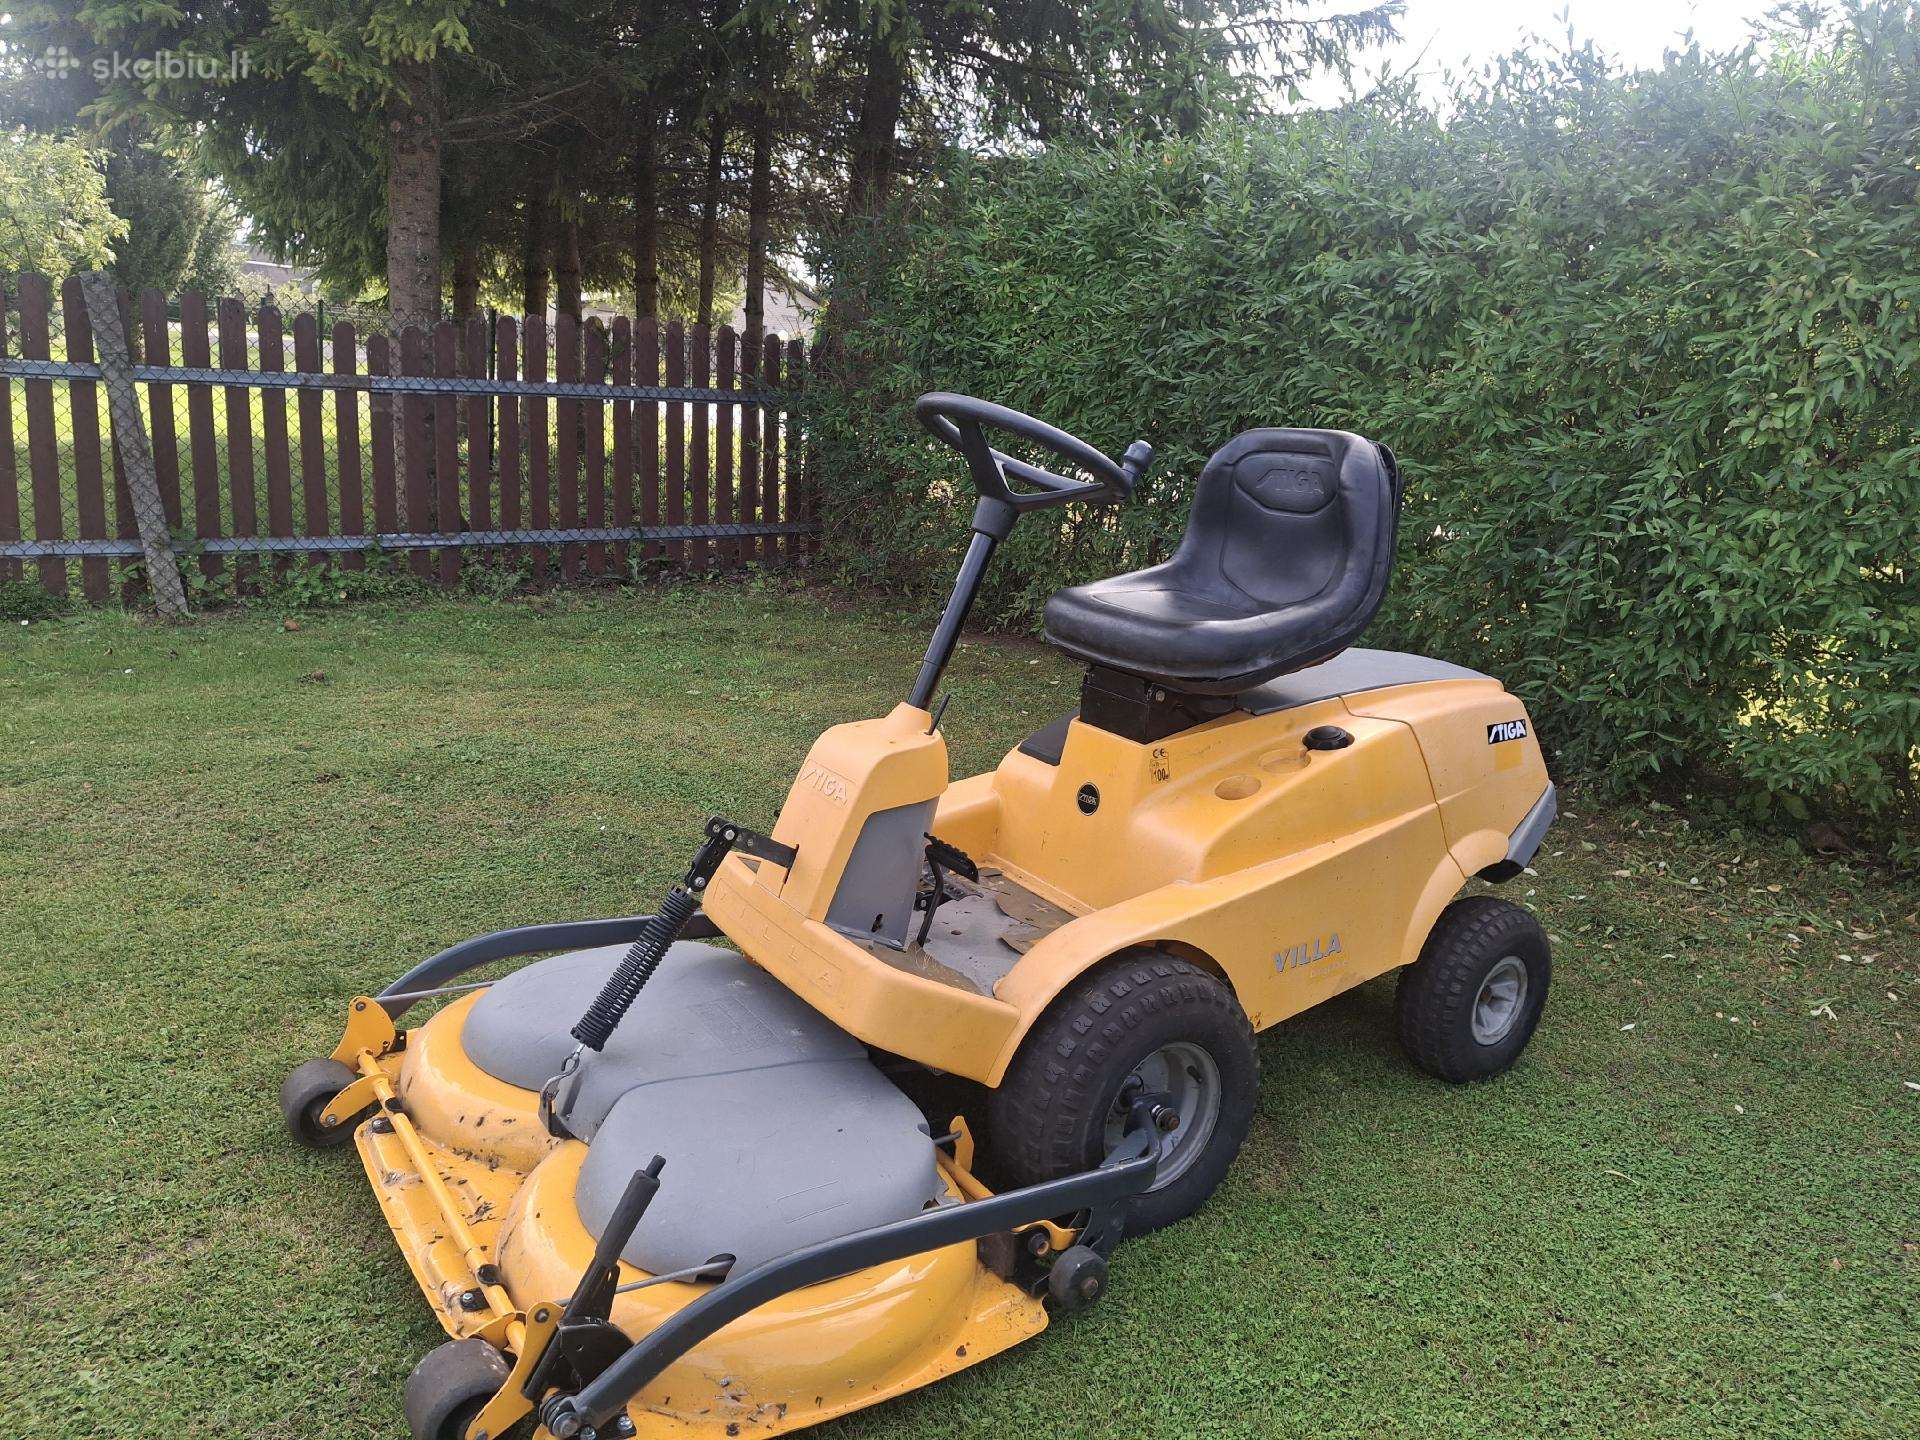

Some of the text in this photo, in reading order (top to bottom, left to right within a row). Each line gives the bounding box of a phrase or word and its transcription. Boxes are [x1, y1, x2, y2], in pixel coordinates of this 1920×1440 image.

[1489, 720, 1526, 743] STIGA
[799, 768, 848, 807] STIGA
[1274, 932, 1341, 972] VILLA
